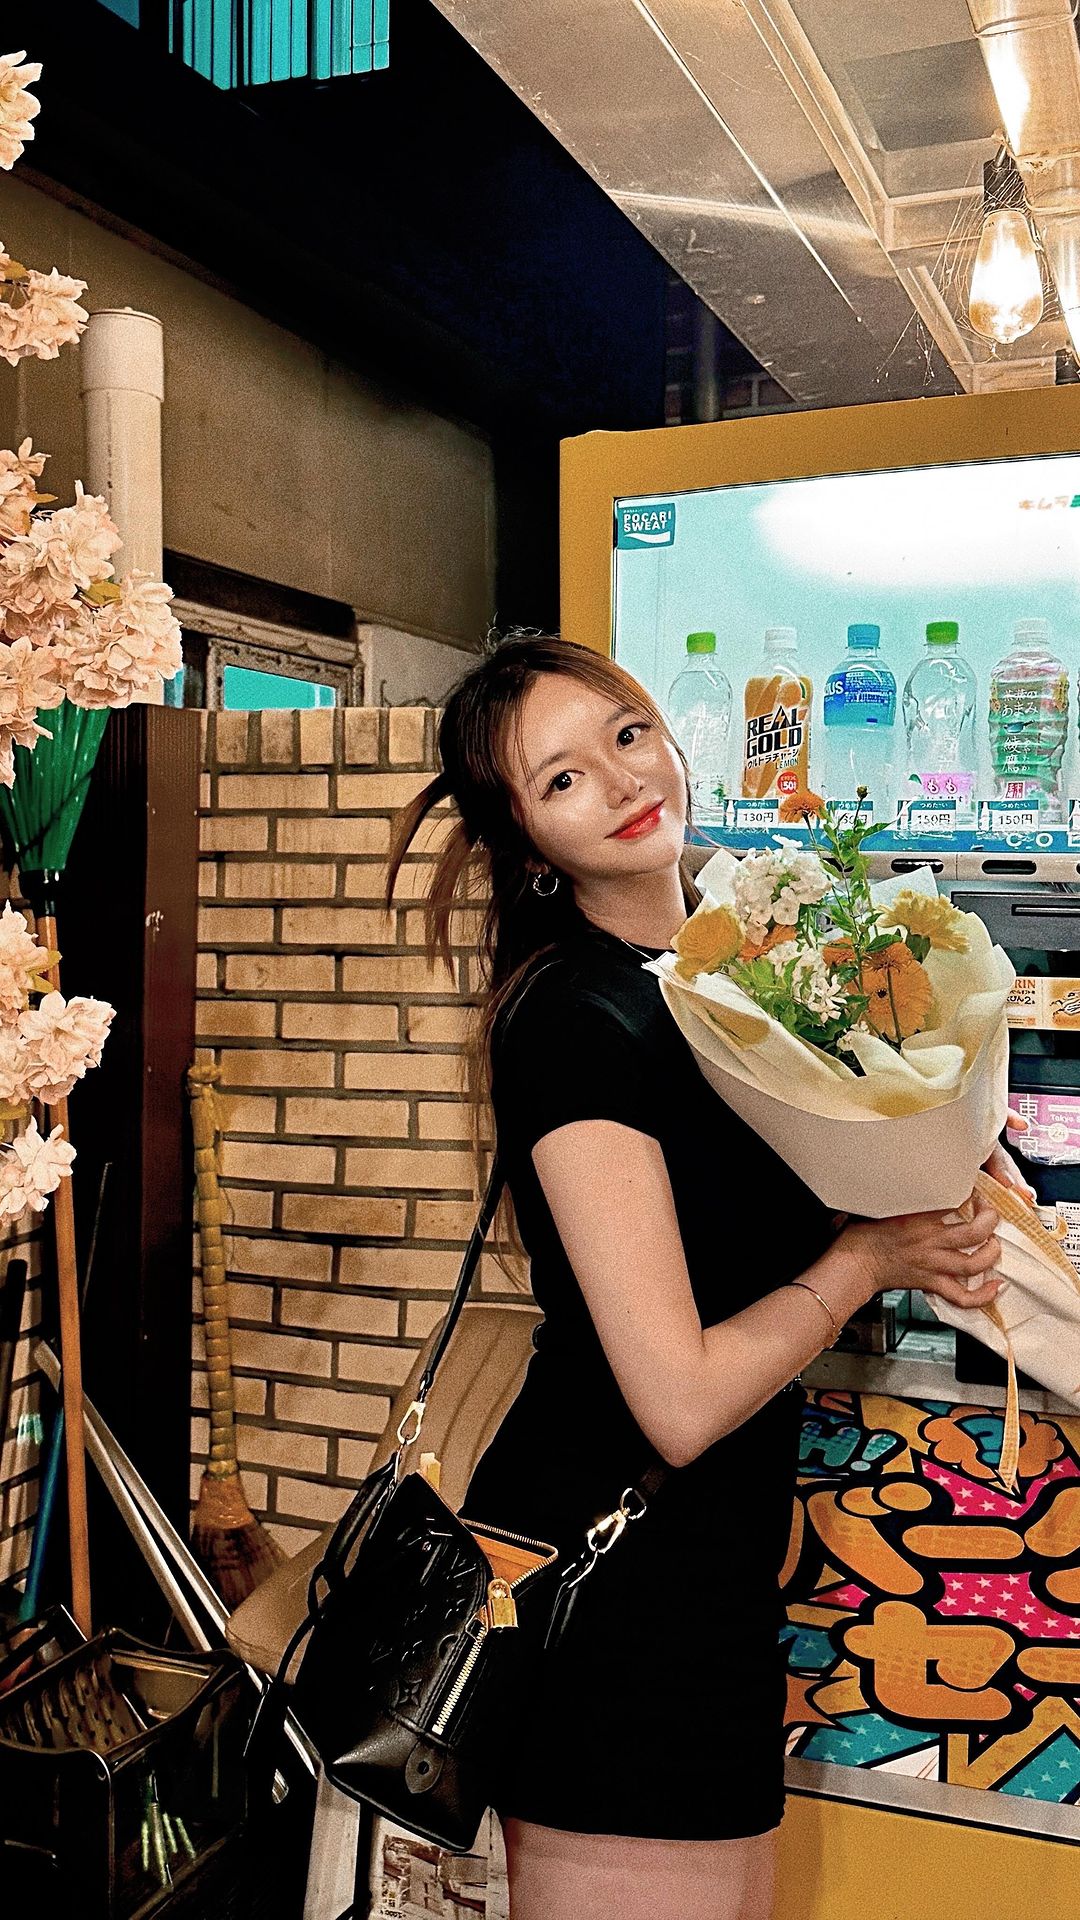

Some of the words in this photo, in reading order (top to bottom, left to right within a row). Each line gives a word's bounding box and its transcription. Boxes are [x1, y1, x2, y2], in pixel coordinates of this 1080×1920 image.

[623, 510, 672, 525] POCARI
[623, 520, 667, 532] SWEAT
[1002, 702, 1038, 717] あまみ
[747, 705, 802, 739] REAL
[747, 726, 802, 759] GOLD
[775, 758, 799, 770] LEMON
[927, 778, 959, 795] もも
[743, 812, 774, 823] 130円
[999, 813, 1033, 825] 150円
[1050, 1115, 1074, 1123] Tokyo
